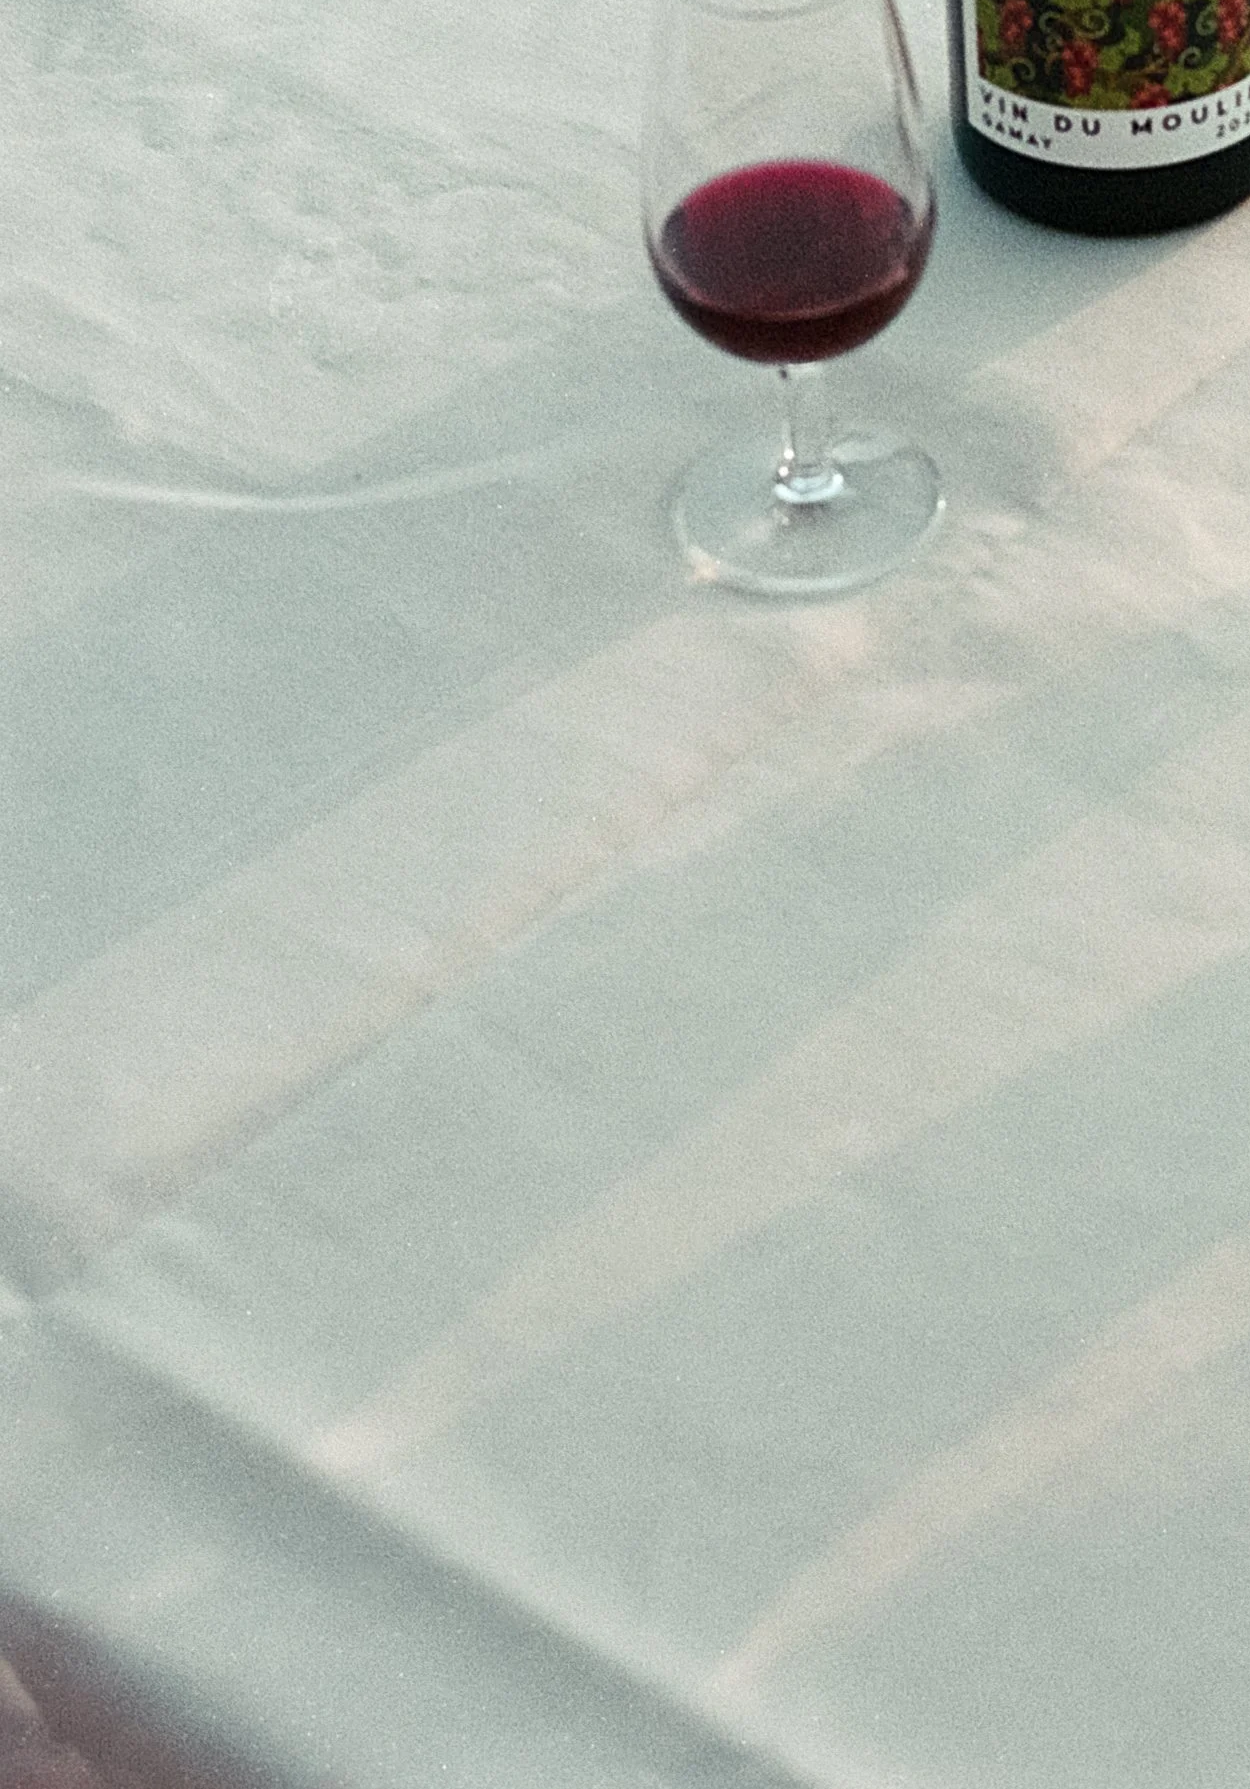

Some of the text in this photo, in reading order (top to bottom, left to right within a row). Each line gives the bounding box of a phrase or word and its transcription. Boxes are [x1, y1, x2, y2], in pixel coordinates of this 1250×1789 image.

[979, 84, 1028, 123] VIN
[1053, 113, 1101, 137] DU
[982, 112, 1051, 150] GAMAY
